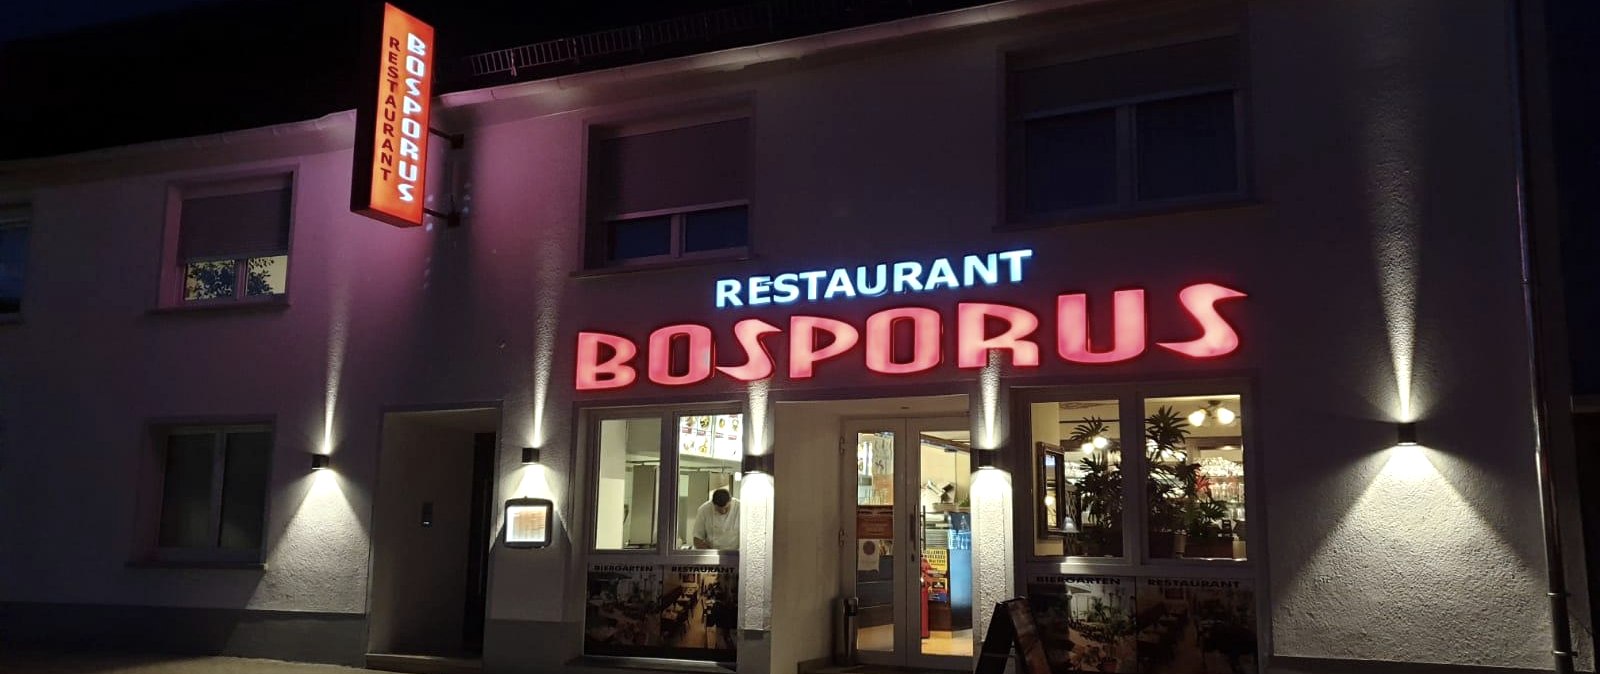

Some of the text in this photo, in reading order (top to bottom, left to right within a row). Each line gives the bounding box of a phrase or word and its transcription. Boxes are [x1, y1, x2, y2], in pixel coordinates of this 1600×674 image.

[380, 36, 401, 181] RESTAURANT
[397, 32, 426, 203] BOSPORUS
[715, 248, 1033, 308] RESTAURANT
[575, 283, 1248, 391] BOSPORUS
[1036, 576, 1121, 585] BIERGARTEN
[1147, 579, 1240, 589] RESTAURANT
